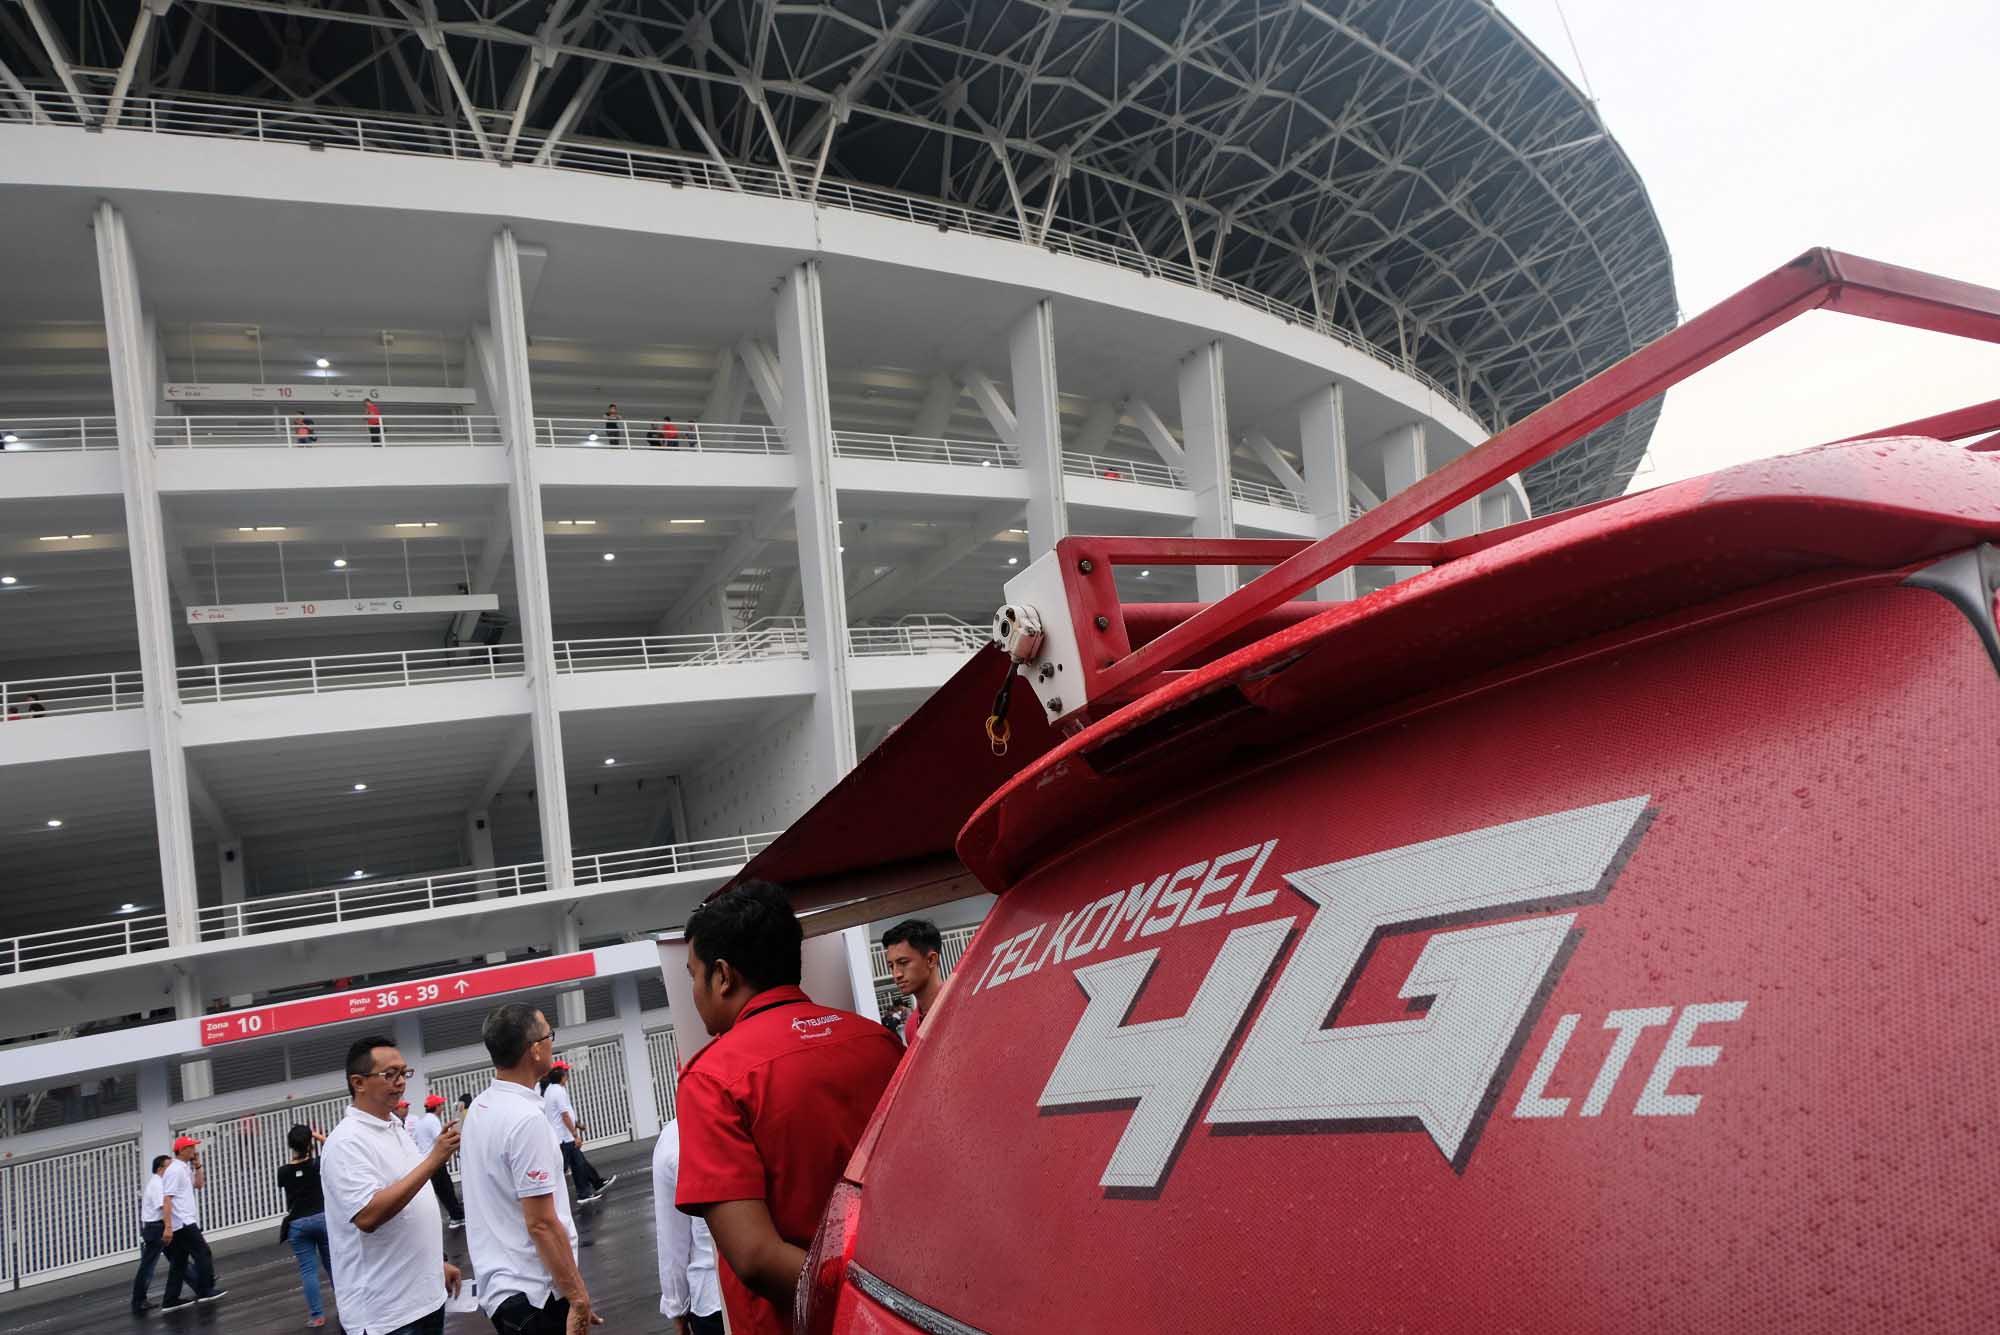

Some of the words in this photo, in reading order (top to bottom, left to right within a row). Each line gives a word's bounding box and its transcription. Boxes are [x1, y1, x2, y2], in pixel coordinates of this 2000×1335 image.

[277, 387, 292, 398] 10
[369, 389, 379, 399] G
[301, 604, 315, 614] 10
[393, 600, 402, 610] G
[972, 839, 1278, 995] TELKOMSEL
[349, 998, 371, 1007] Pintu
[376, 991, 399, 1009] 36
[416, 984, 439, 1002] 39
[1037, 795, 1652, 1187] 4G
[1514, 1001, 1747, 1118] LTE
[206, 1022, 229, 1031] Zona
[237, 1015, 262, 1033] 10
